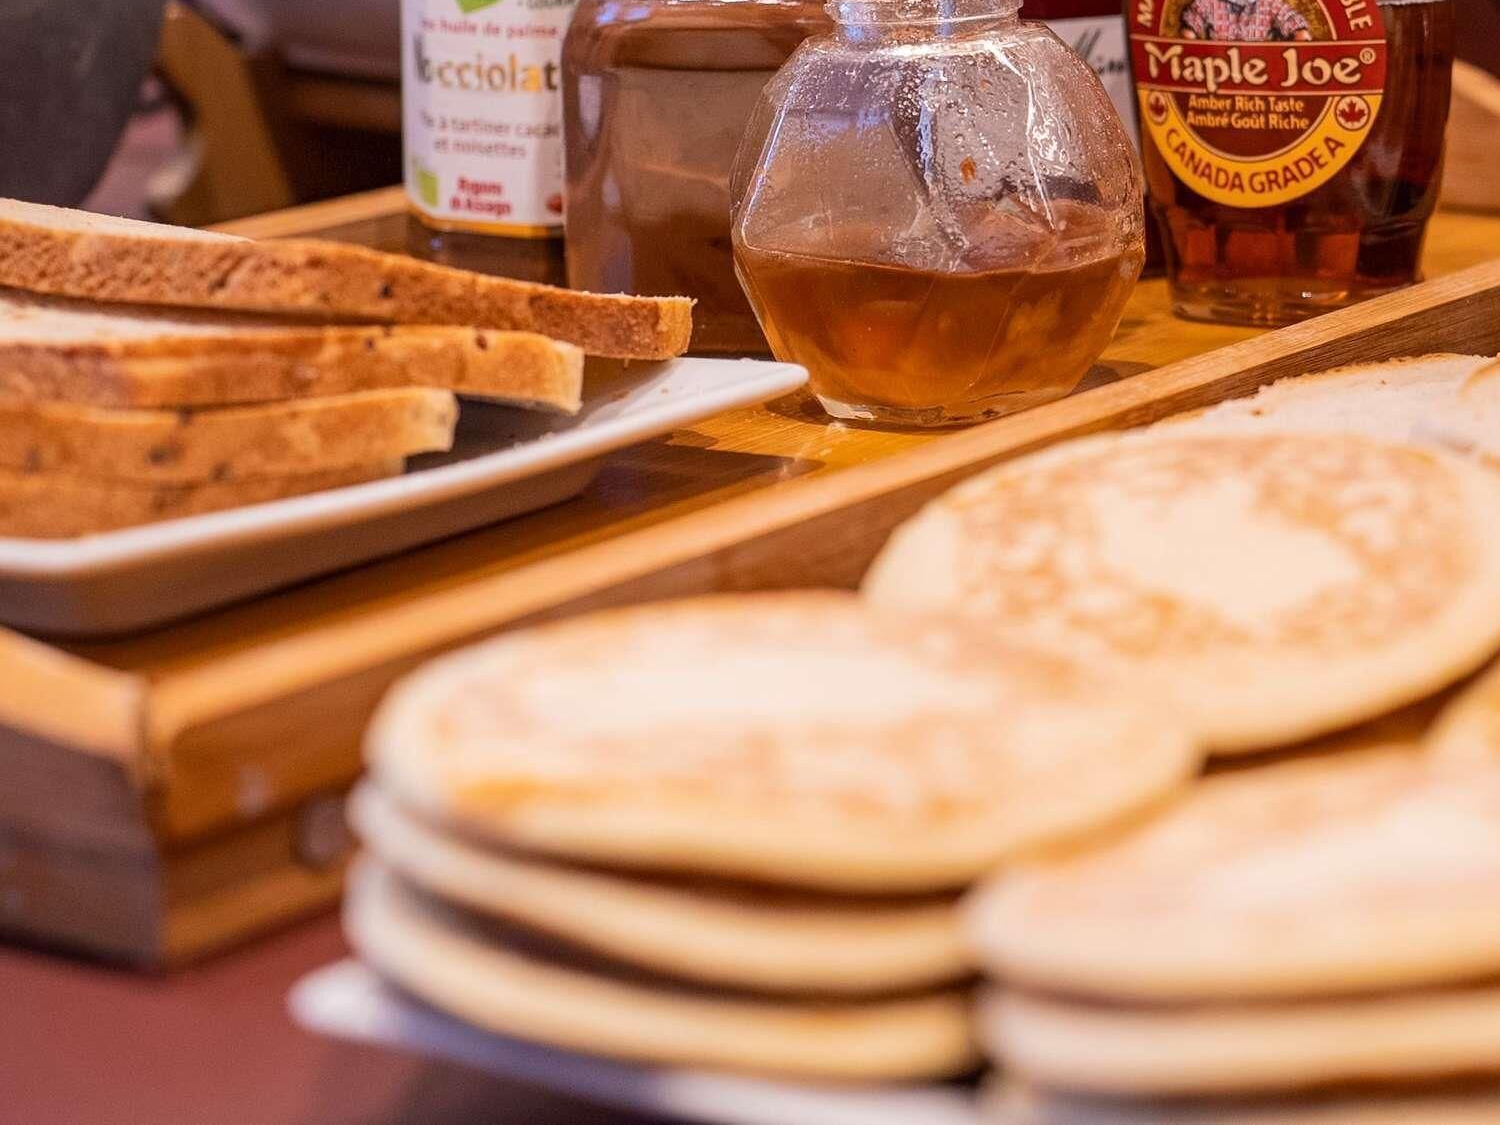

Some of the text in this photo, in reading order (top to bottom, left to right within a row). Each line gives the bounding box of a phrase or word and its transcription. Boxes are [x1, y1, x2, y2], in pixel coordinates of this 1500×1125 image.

[1145, 42, 1268, 92] Maple
[1186, 110, 1310, 131] Ambré Goût Riche
[1188, 95, 1304, 113] Amber Rich Taste
[1165, 128, 1345, 194] CANADA GRADE A
